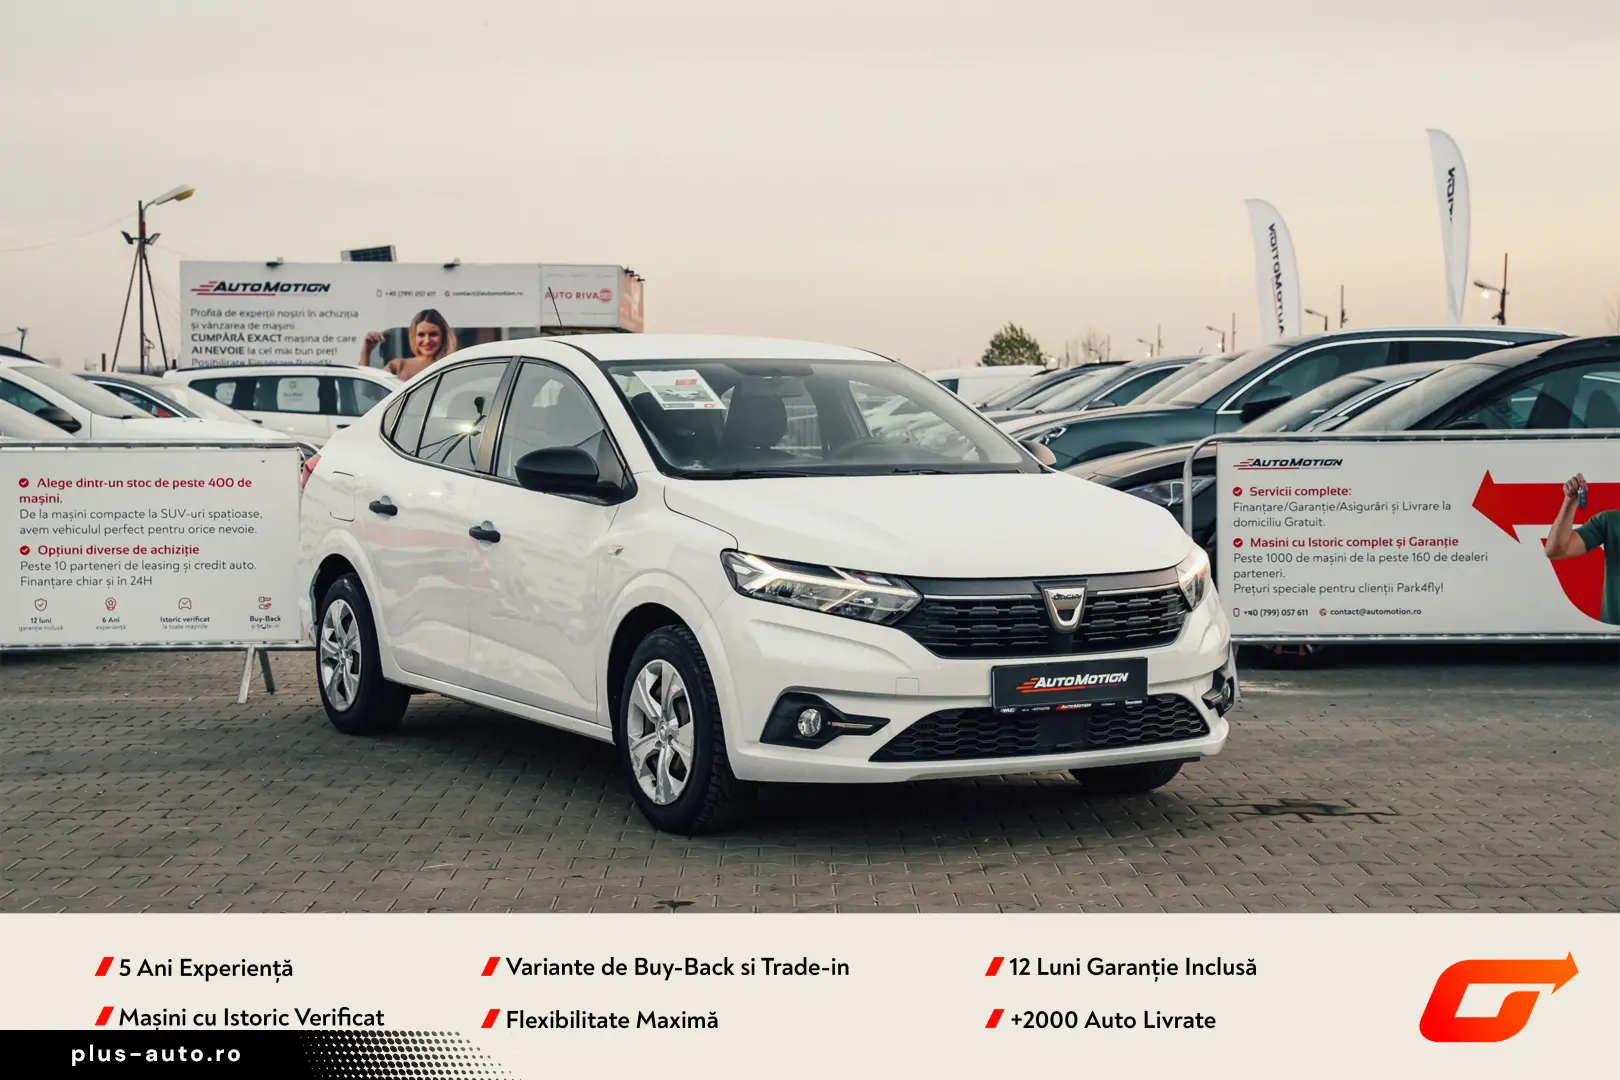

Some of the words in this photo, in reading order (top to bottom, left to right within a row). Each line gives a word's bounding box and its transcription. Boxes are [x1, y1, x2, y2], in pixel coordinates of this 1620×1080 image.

[213, 282, 330, 292] AUTOMOTION
[191, 333, 245, 342] CUMPĂRĂ
[248, 334, 282, 342] EXACT
[285, 335, 319, 344] mașina
[322, 334, 334, 342] de
[37, 478, 72, 490] Alege
[76, 478, 123, 488] dintr-un
[127, 479, 151, 488] stoc
[155, 478, 169, 487] de
[173, 479, 205, 489] peste
[208, 478, 234, 487] 400
[238, 478, 252, 487] de
[1250, 487, 1291, 496] Servicii
[1295, 486, 1352, 498] complete:
[20, 494, 62, 505] mașini.
[1234, 501, 1388, 514] Finanțare/Garanție/Asigurări
[1392, 502, 1399, 514] și
[1403, 501, 1439, 511] Livrare
[1443, 500, 1451, 510] la
[20, 509, 36, 519] De
[39, 509, 48, 519] la
[52, 510, 86, 522] mașini
[90, 510, 145, 521] compacte
[149, 509, 157, 518] la
[161, 509, 204, 518] SUV-uri
[208, 509, 262, 521] spațioase,
[1233, 517, 1281, 527] domiciliu
[1284, 517, 1326, 527] Gratuit.
[52, 524, 100, 534] vehiculul
[104, 524, 144, 536] perfect
[148, 525, 184, 536] pentru
[188, 524, 215, 534] orice
[219, 524, 257, 534] nevoie.
[1251, 537, 1288, 547] Masini
[1309, 537, 1343, 547] Istoric
[1346, 537, 1393, 549] complet
[1396, 537, 1405, 549] și
[1409, 537, 1458, 548] Garanție
[38, 545, 82, 557] Opțiuni
[86, 545, 129, 554] diverse
[133, 545, 147, 554] de
[151, 545, 199, 556] achiziție
[1234, 553, 1263, 563] Peste
[1266, 553, 1292, 563] 1000
[1296, 553, 1310, 562] de
[1313, 553, 1346, 565] mașini
[1350, 552, 1363, 562] de
[1367, 552, 1375, 562] la
[1379, 554, 1409, 564] peste
[1412, 552, 1430, 562] 160
[1434, 552, 1448, 562] de
[1451, 552, 1487, 562] dealeri
[21, 561, 51, 571] Peste
[55, 561, 66, 570] 10
[70, 561, 121, 573] parteneri
[124, 560, 138, 570] de
[142, 560, 179, 573] leasing
[183, 560, 191, 573] și
[194, 560, 226, 570] credit
[229, 561, 256, 570] auto.
[1234, 569, 1285, 580] parteneri.
[21, 576, 73, 589] Finanțare
[76, 576, 103, 586] chiar
[106, 576, 114, 589] și
[117, 576, 127, 585] în
[131, 576, 152, 585] 24H
[1234, 584, 1269, 596] Prețuri
[1273, 583, 1316, 595] speciale
[1319, 585, 1355, 595] pentru
[1358, 583, 1393, 595] clienții
[1397, 582, 1443, 595] Park4fly!
[1260, 609, 1279, 617] (799)
[30, 616, 37, 624] 12
[39, 616, 52, 624] luni
[250, 616, 281, 624] Buy-Back
[1034, 673, 1129, 688] AUTOMOTION
